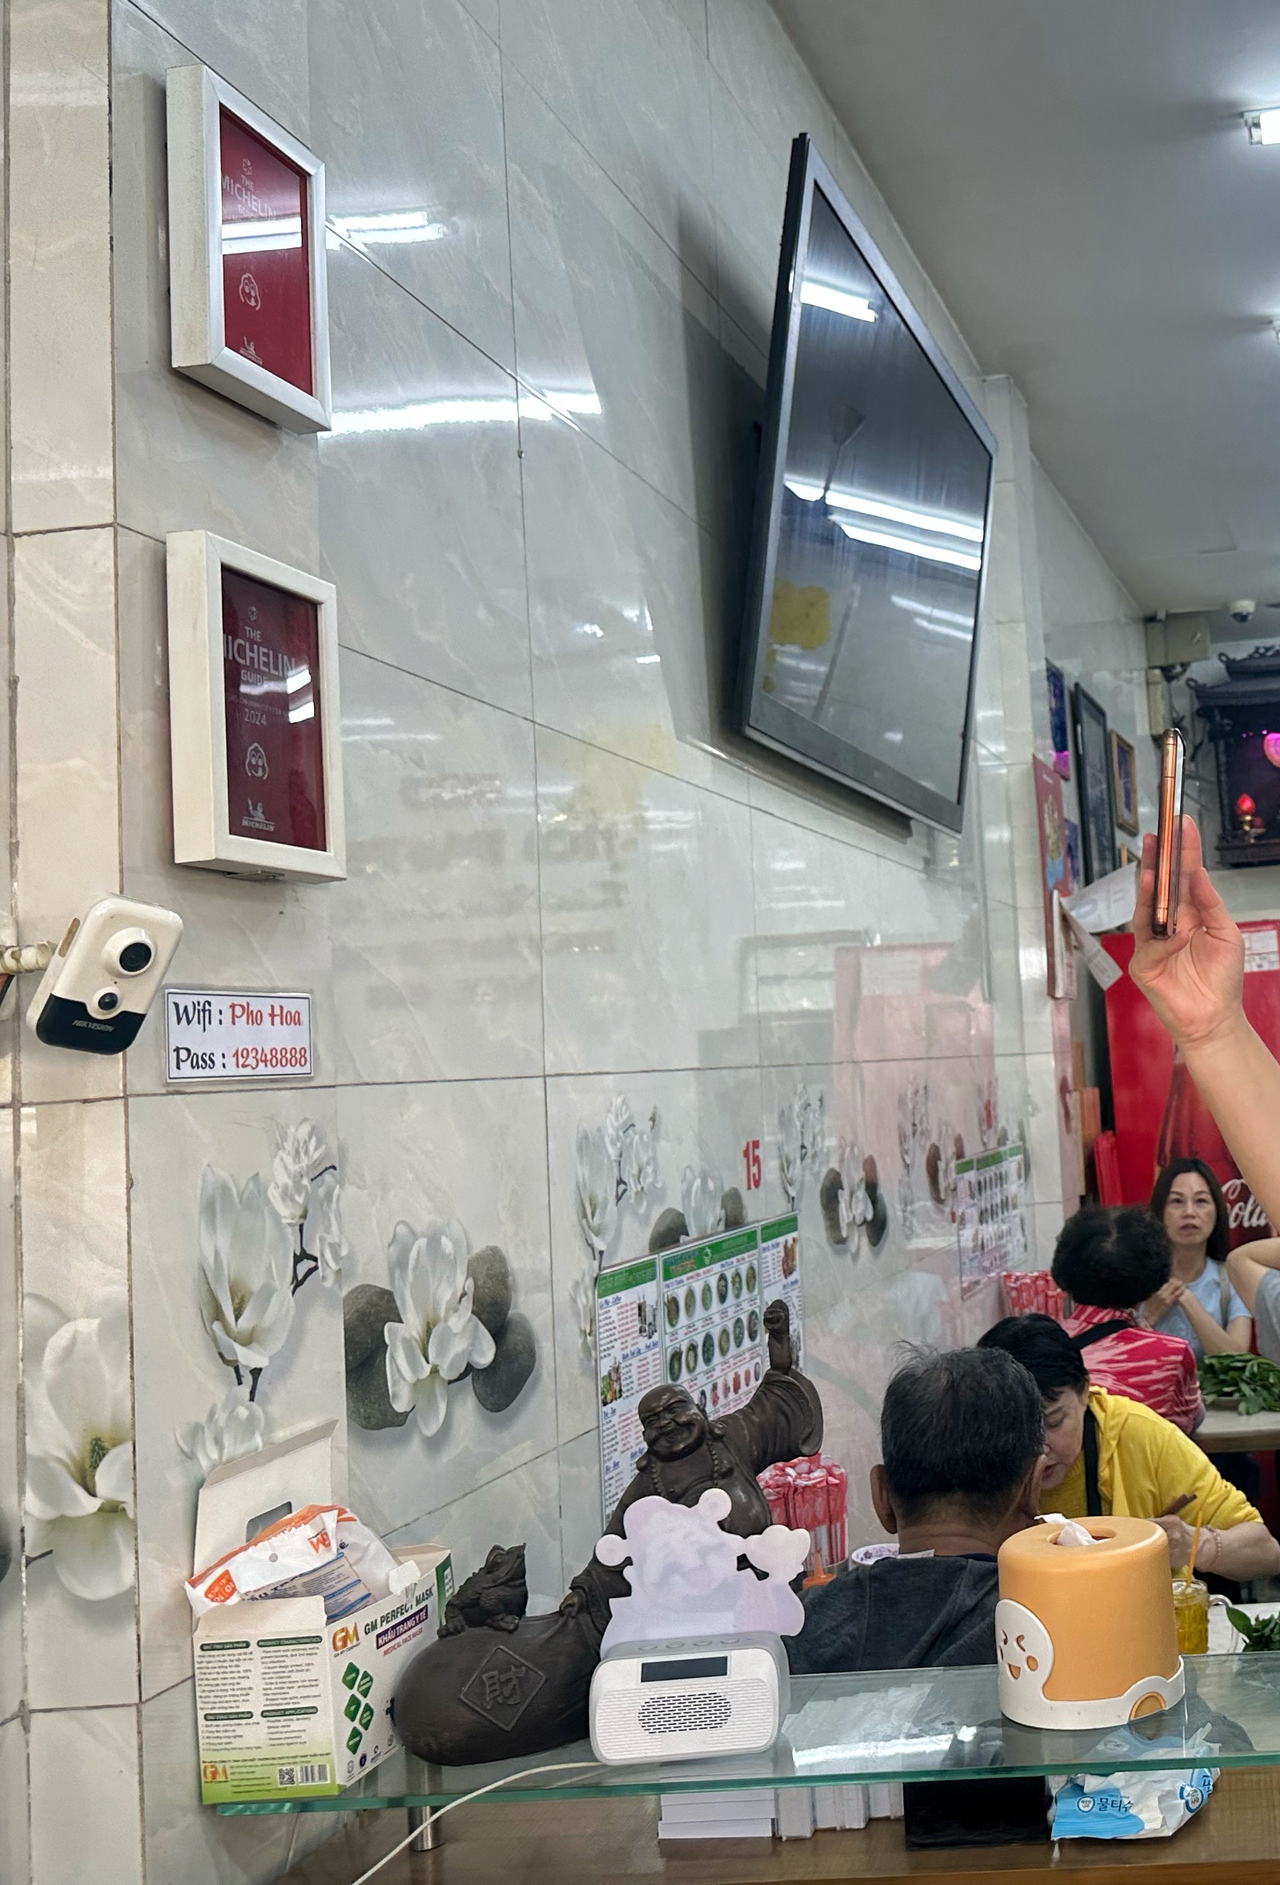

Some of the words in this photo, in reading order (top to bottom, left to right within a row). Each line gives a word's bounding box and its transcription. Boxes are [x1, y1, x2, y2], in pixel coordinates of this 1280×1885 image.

[241, 174, 255, 191] THE
[222, 174, 277, 220] MICHELIN
[244, 626, 262, 642] THE
[244, 708, 267, 726] 2024
[72, 1019, 115, 1032] HIKVISION
[173, 1000, 212, 1033] Wifi
[229, 1001, 263, 1026] Pho
[268, 1004, 301, 1027] Hoa
[173, 1046, 216, 1070] Pass
[232, 1046, 308, 1070] 12348888
[743, 1139, 761, 1190] 15
[364, 1619, 378, 1635] GM
[415, 1587, 434, 1606] MASK
[332, 1622, 360, 1652] GM
